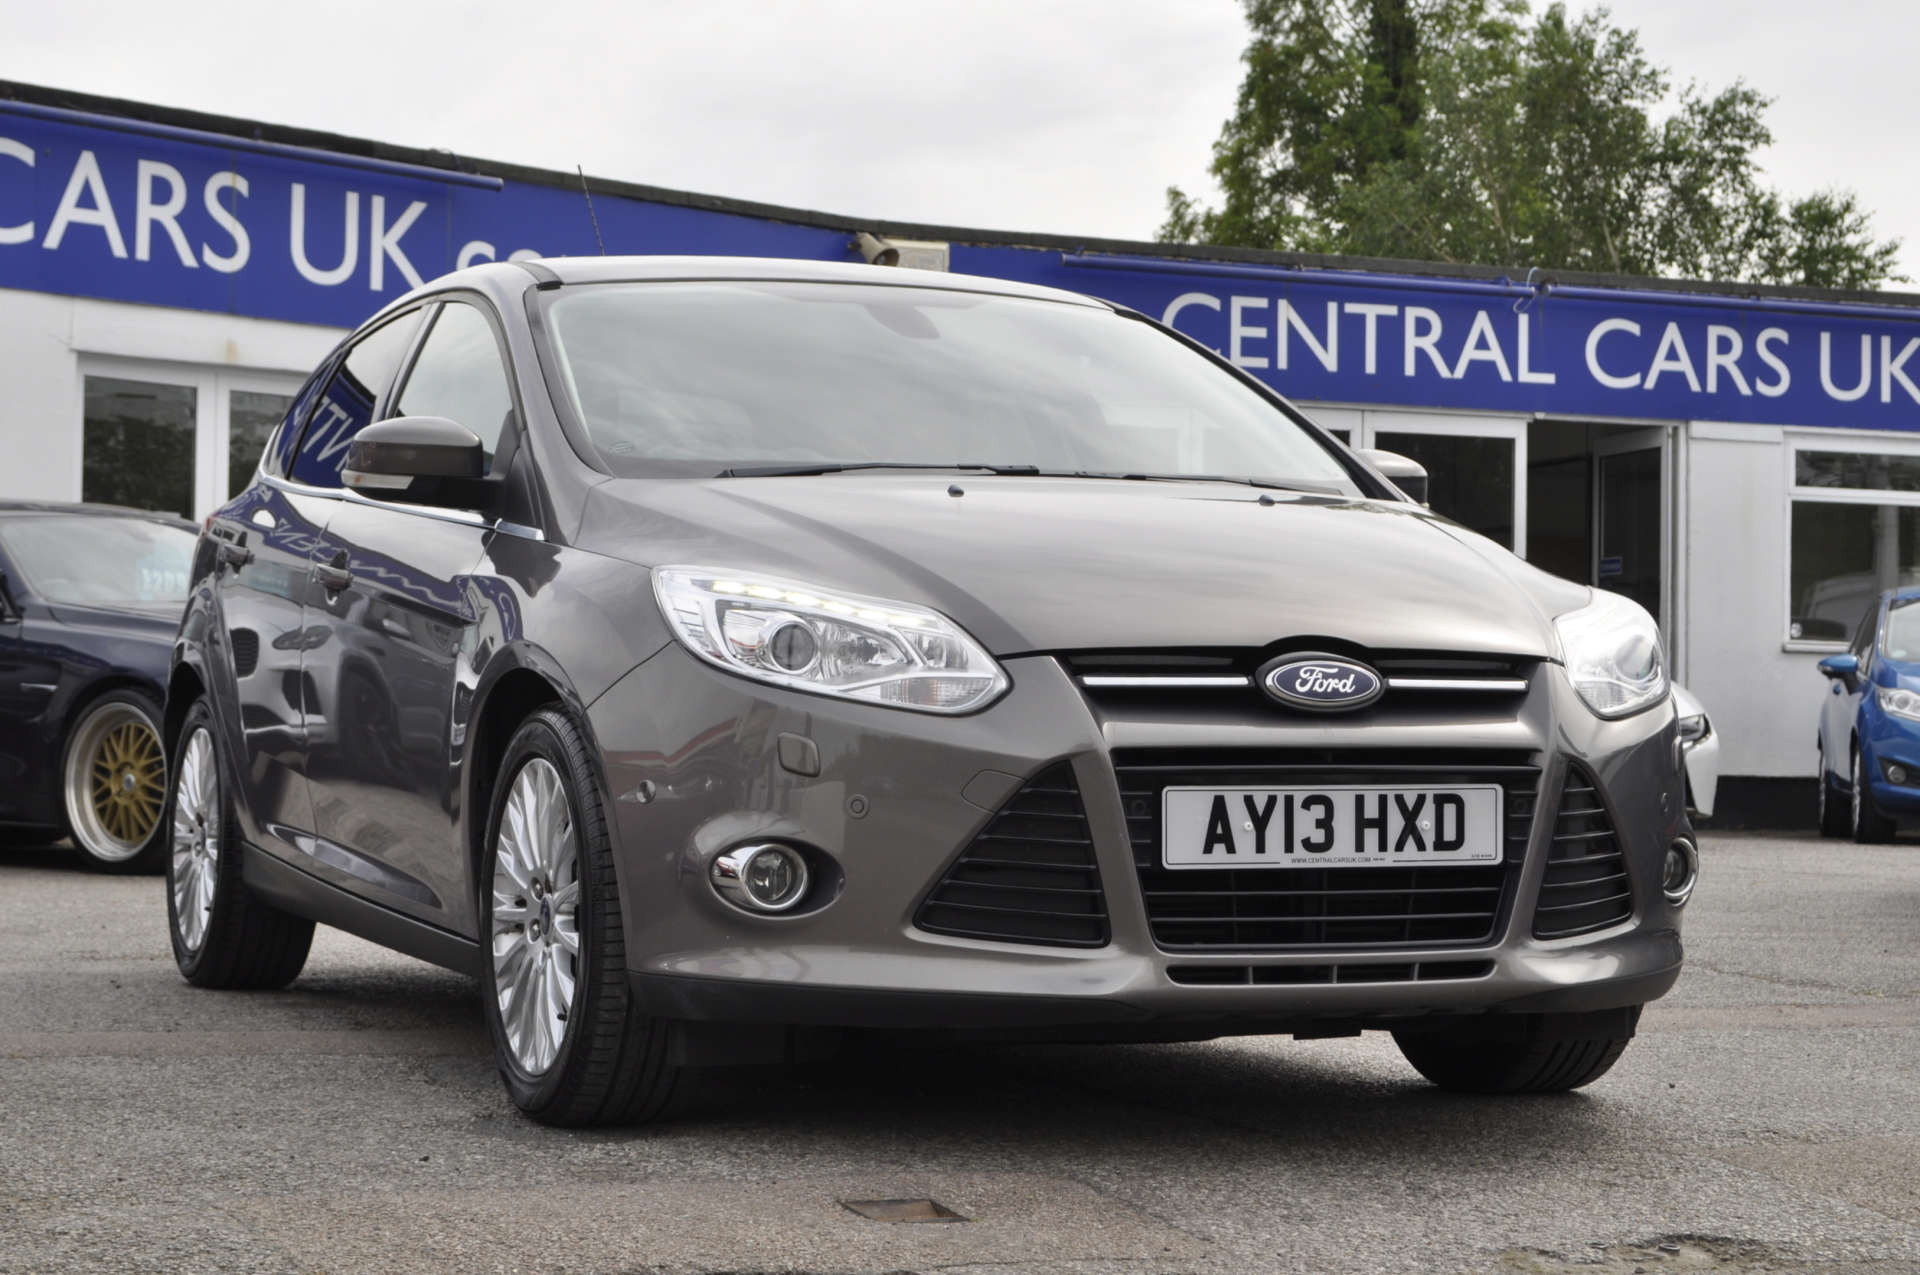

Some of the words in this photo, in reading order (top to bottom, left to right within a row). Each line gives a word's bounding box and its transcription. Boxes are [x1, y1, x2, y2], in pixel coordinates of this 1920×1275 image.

[290, 183, 428, 292] UK
[1161, 292, 1556, 385] CENTRAL
[1585, 318, 1791, 397] CARS
[1820, 332, 1920, 405] UK
[1294, 666, 1356, 693] Ford
[1202, 794, 1335, 855] AY13
[1354, 793, 1466, 853] HXD
